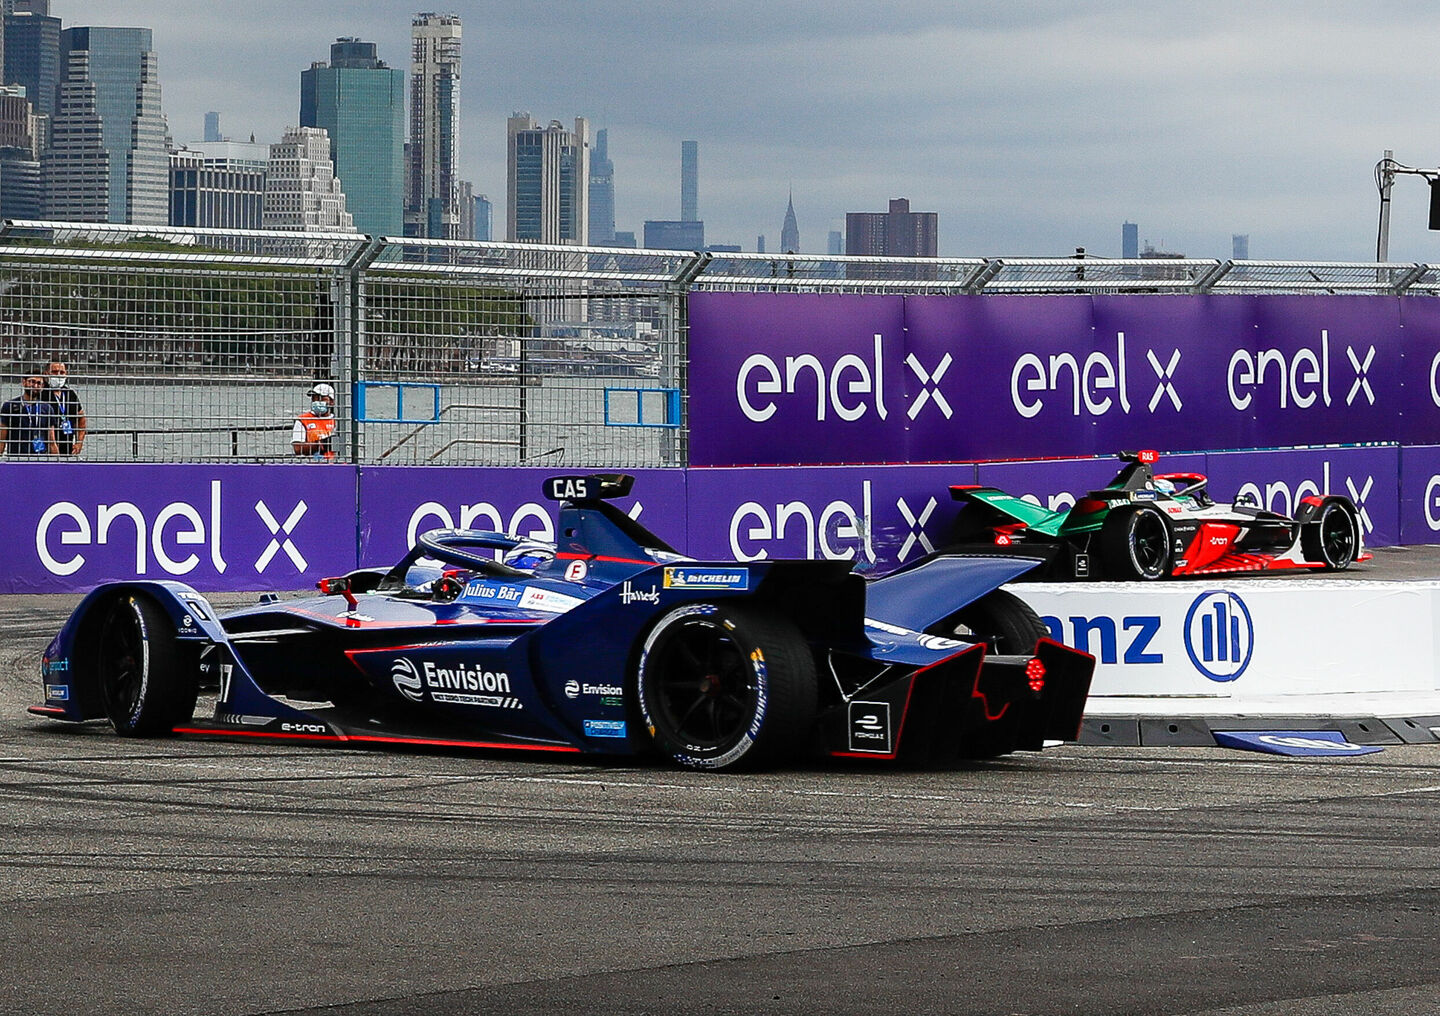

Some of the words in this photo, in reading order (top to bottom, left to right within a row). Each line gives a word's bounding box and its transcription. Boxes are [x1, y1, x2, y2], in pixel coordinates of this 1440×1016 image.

[736, 334, 888, 422] enel
[906, 352, 953, 421] x
[1011, 332, 1131, 418] enel
[1146, 348, 1182, 414] x
[1227, 329, 1333, 411] enel
[1346, 345, 1376, 406] x
[1142, 452, 1155, 461] RAS
[553, 479, 587, 498] CAS
[35, 480, 227, 576] enel
[254, 499, 308, 574] x
[406, 501, 561, 568] ene
[729, 480, 877, 564] enel
[896, 495, 938, 563] x
[462, 583, 496, 599] Julius
[686, 574, 741, 584] MICHELIN
[423, 662, 510, 693] Envision
[582, 683, 623, 695] Envision
[281, 722, 326, 733] e-tron
